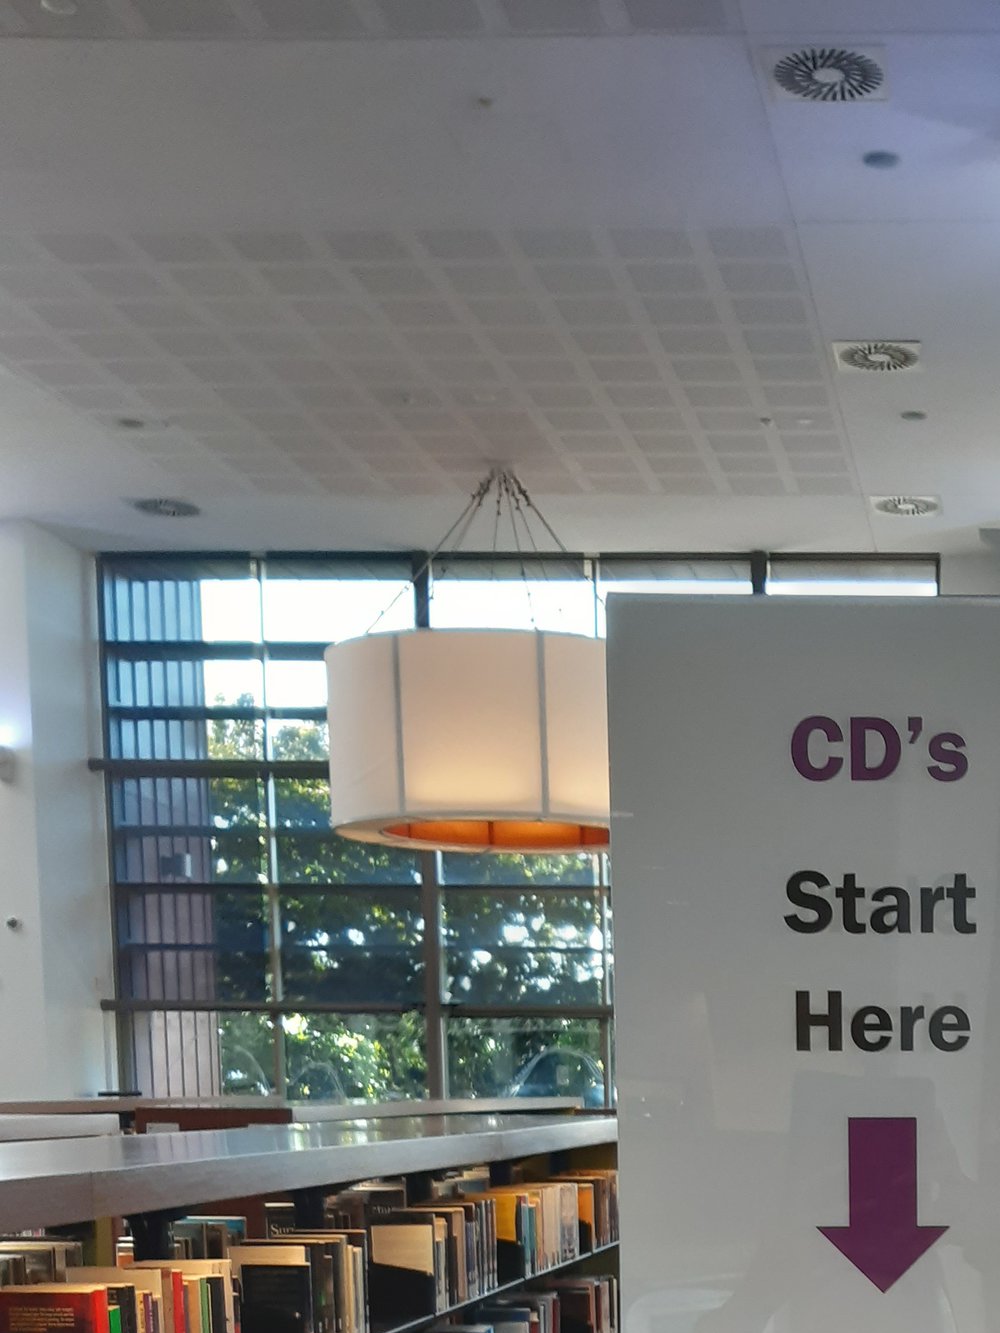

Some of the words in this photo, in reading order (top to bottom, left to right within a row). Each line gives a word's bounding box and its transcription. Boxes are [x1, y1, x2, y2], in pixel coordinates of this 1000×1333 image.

[790, 715, 969, 782] CD's
[783, 870, 977, 935] Start
[794, 990, 971, 1053] Here
